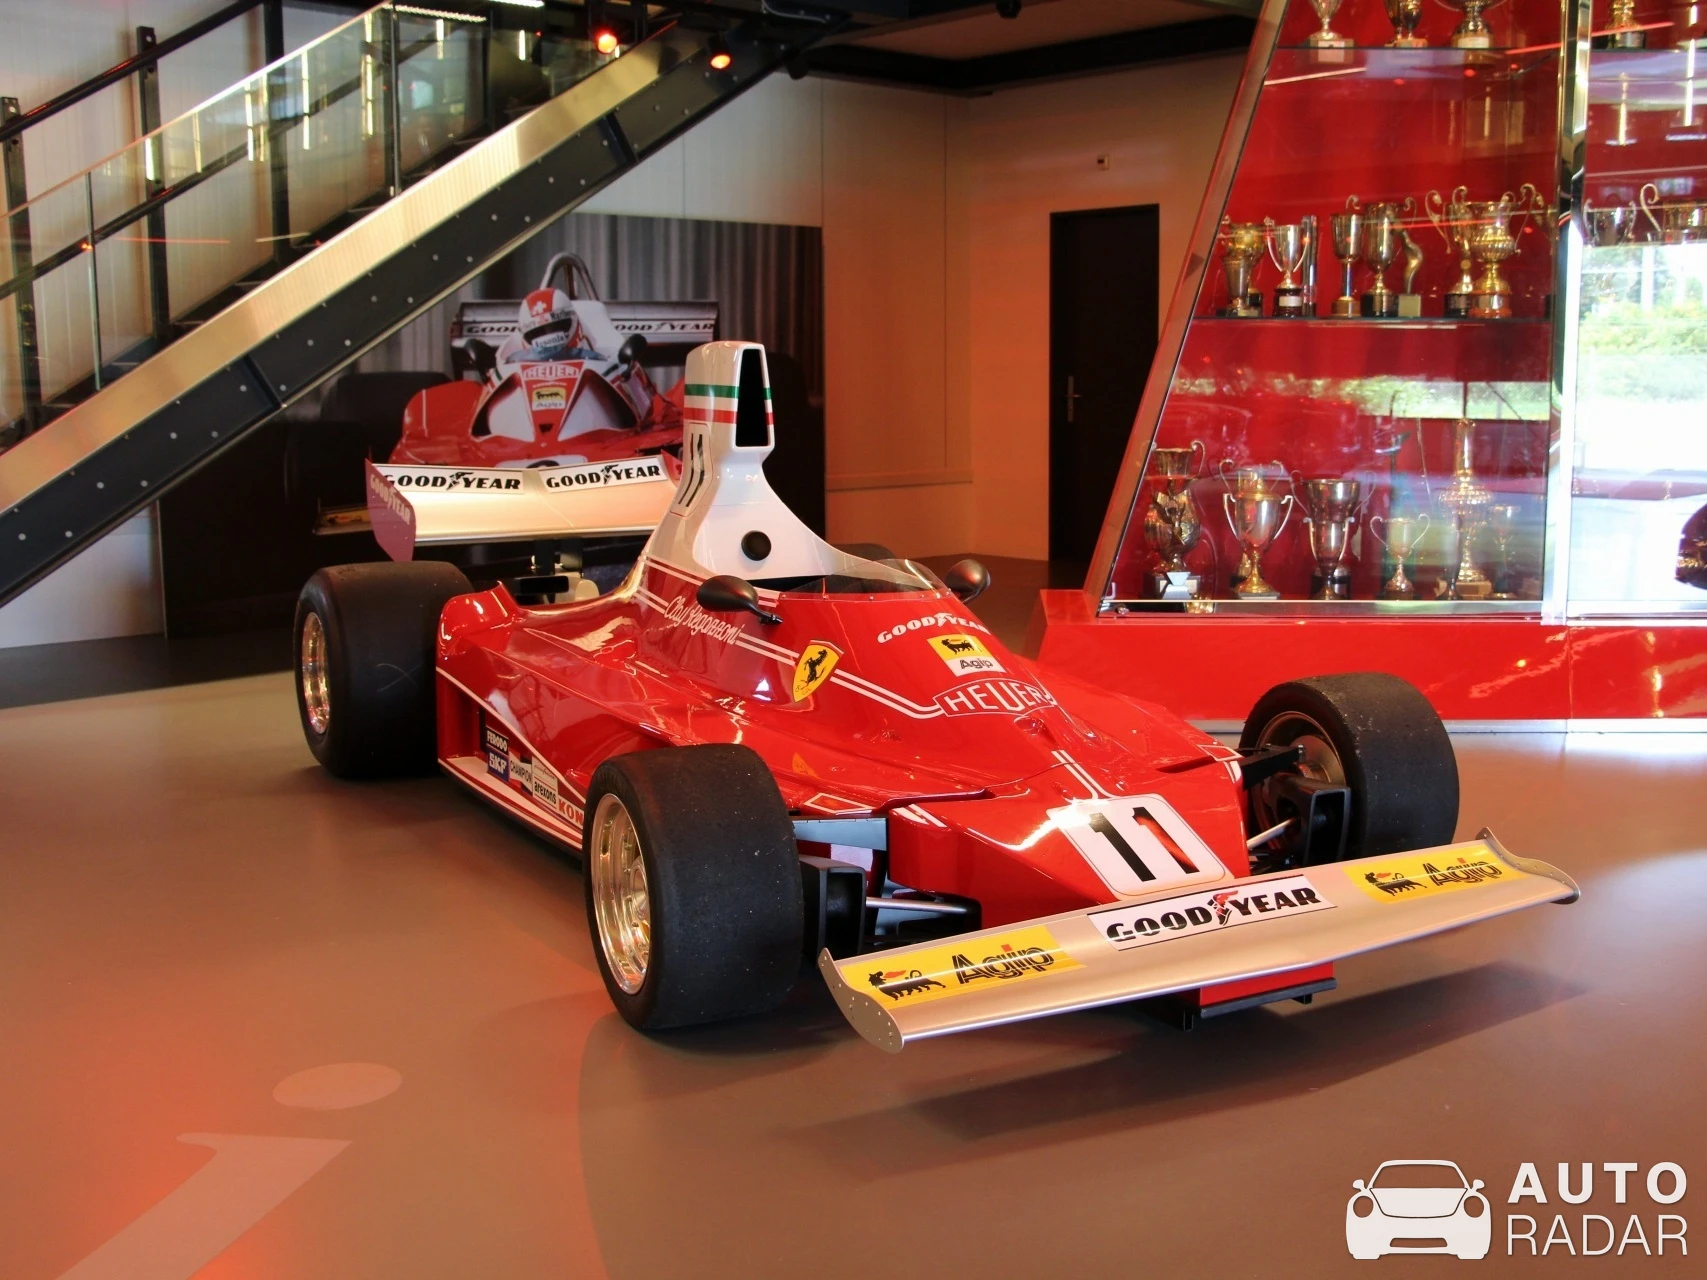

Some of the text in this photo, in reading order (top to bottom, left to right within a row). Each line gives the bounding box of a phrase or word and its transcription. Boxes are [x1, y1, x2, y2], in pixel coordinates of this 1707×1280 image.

[466, 325, 521, 333] GOO
[960, 658, 993, 670] Agip
[943, 681, 1048, 711] HEUER
[486, 731, 508, 752] FERODO
[489, 754, 507, 775] SKF
[510, 761, 533, 784] CHAMPION
[534, 781, 557, 804] arexons
[1088, 806, 1200, 882] 11
[1422, 857, 1503, 887] Agip
[952, 944, 1055, 985] Agip
